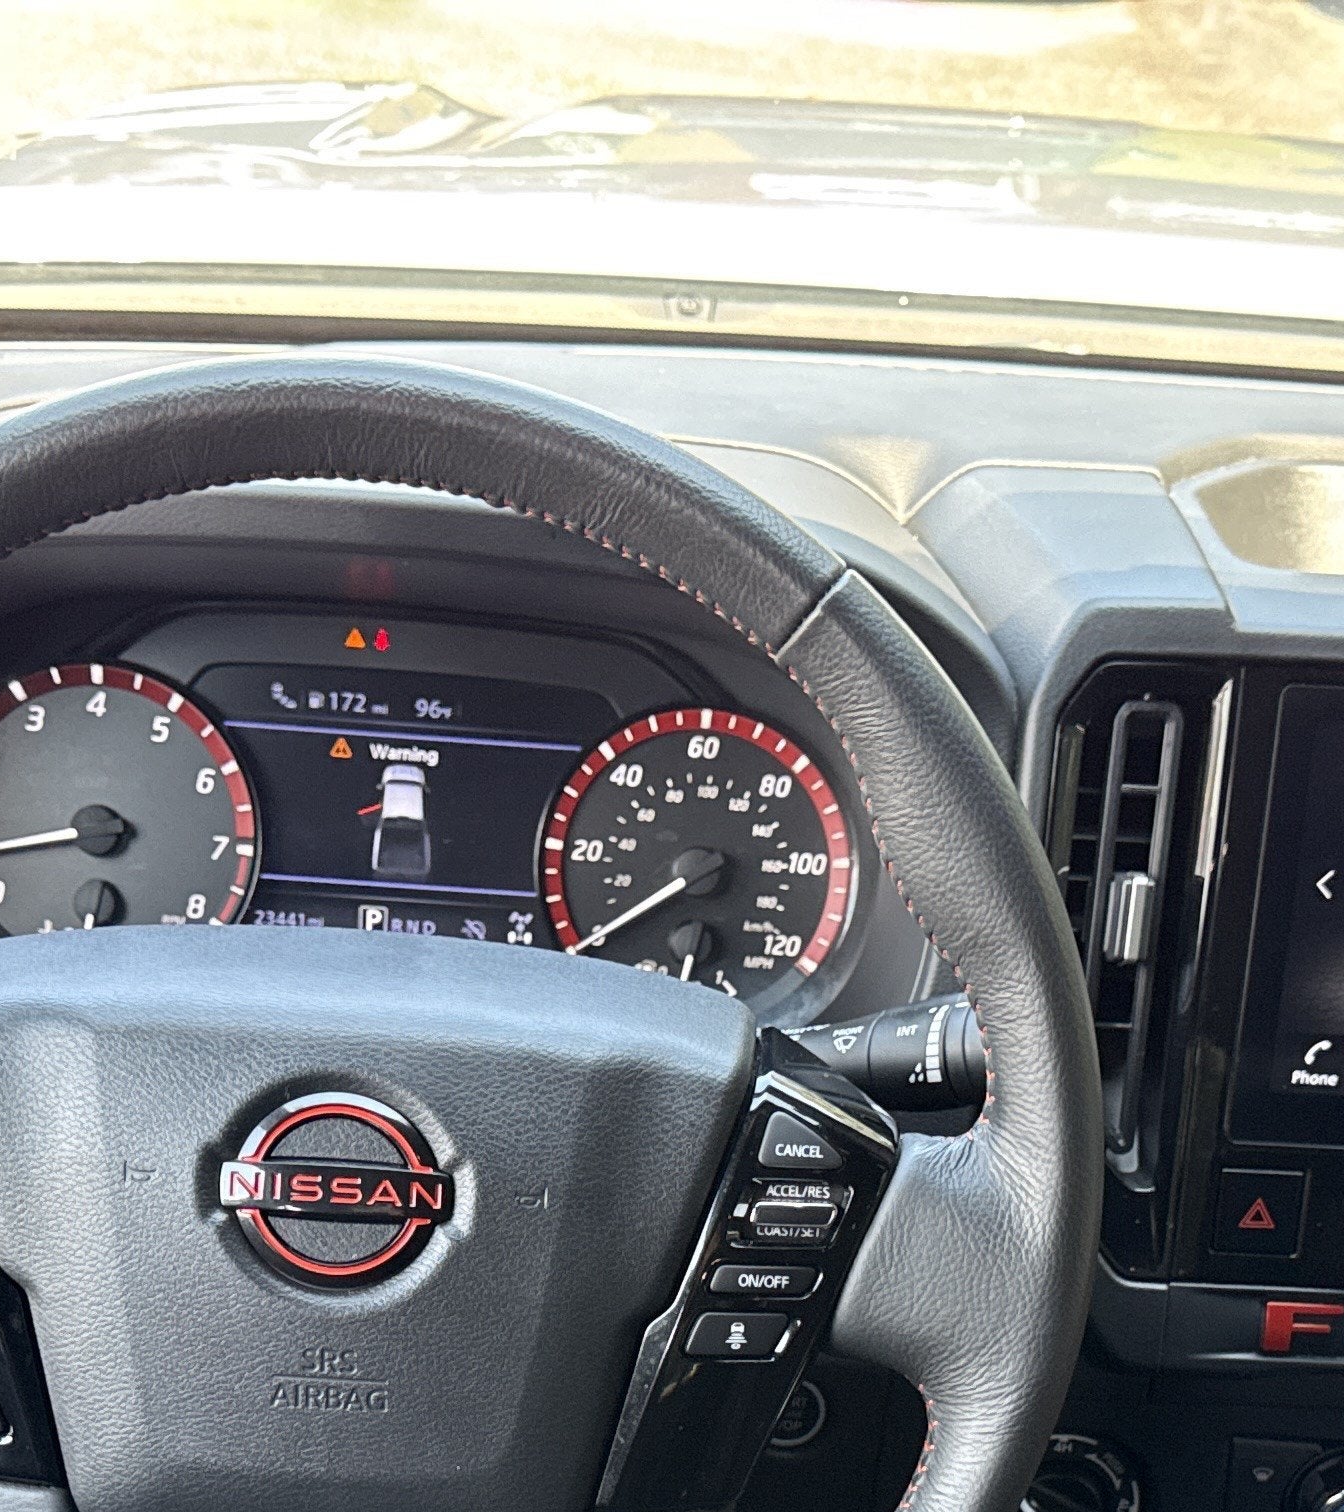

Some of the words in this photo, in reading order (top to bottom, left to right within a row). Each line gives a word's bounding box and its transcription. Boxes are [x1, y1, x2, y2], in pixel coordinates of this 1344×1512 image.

[86, 691, 107, 717] 4
[329, 691, 366, 713] 172
[24, 704, 46, 732] 3
[150, 716, 170, 742] 5
[369, 743, 439, 767] Warning
[687, 735, 721, 759] 60
[195, 767, 216, 794] 6
[609, 763, 644, 787] 40
[758, 774, 792, 798] 80
[210, 835, 230, 860] 7
[570, 839, 604, 862] 20
[789, 852, 827, 876] 100
[185, 893, 207, 919] 8
[365, 908, 382, 931] P
[763, 934, 802, 957] 120
[896, 1024, 918, 1037] INT
[1291, 1069, 1339, 1087] Phone
[775, 1143, 824, 1159] CANCEL
[229, 1169, 443, 1210] NISSAN
[766, 1185, 830, 1199] ACCEL/RES
[738, 1273, 790, 1289] ON/OFF
[301, 1346, 357, 1375] SRS
[271, 1382, 389, 1413] AIRBAG
